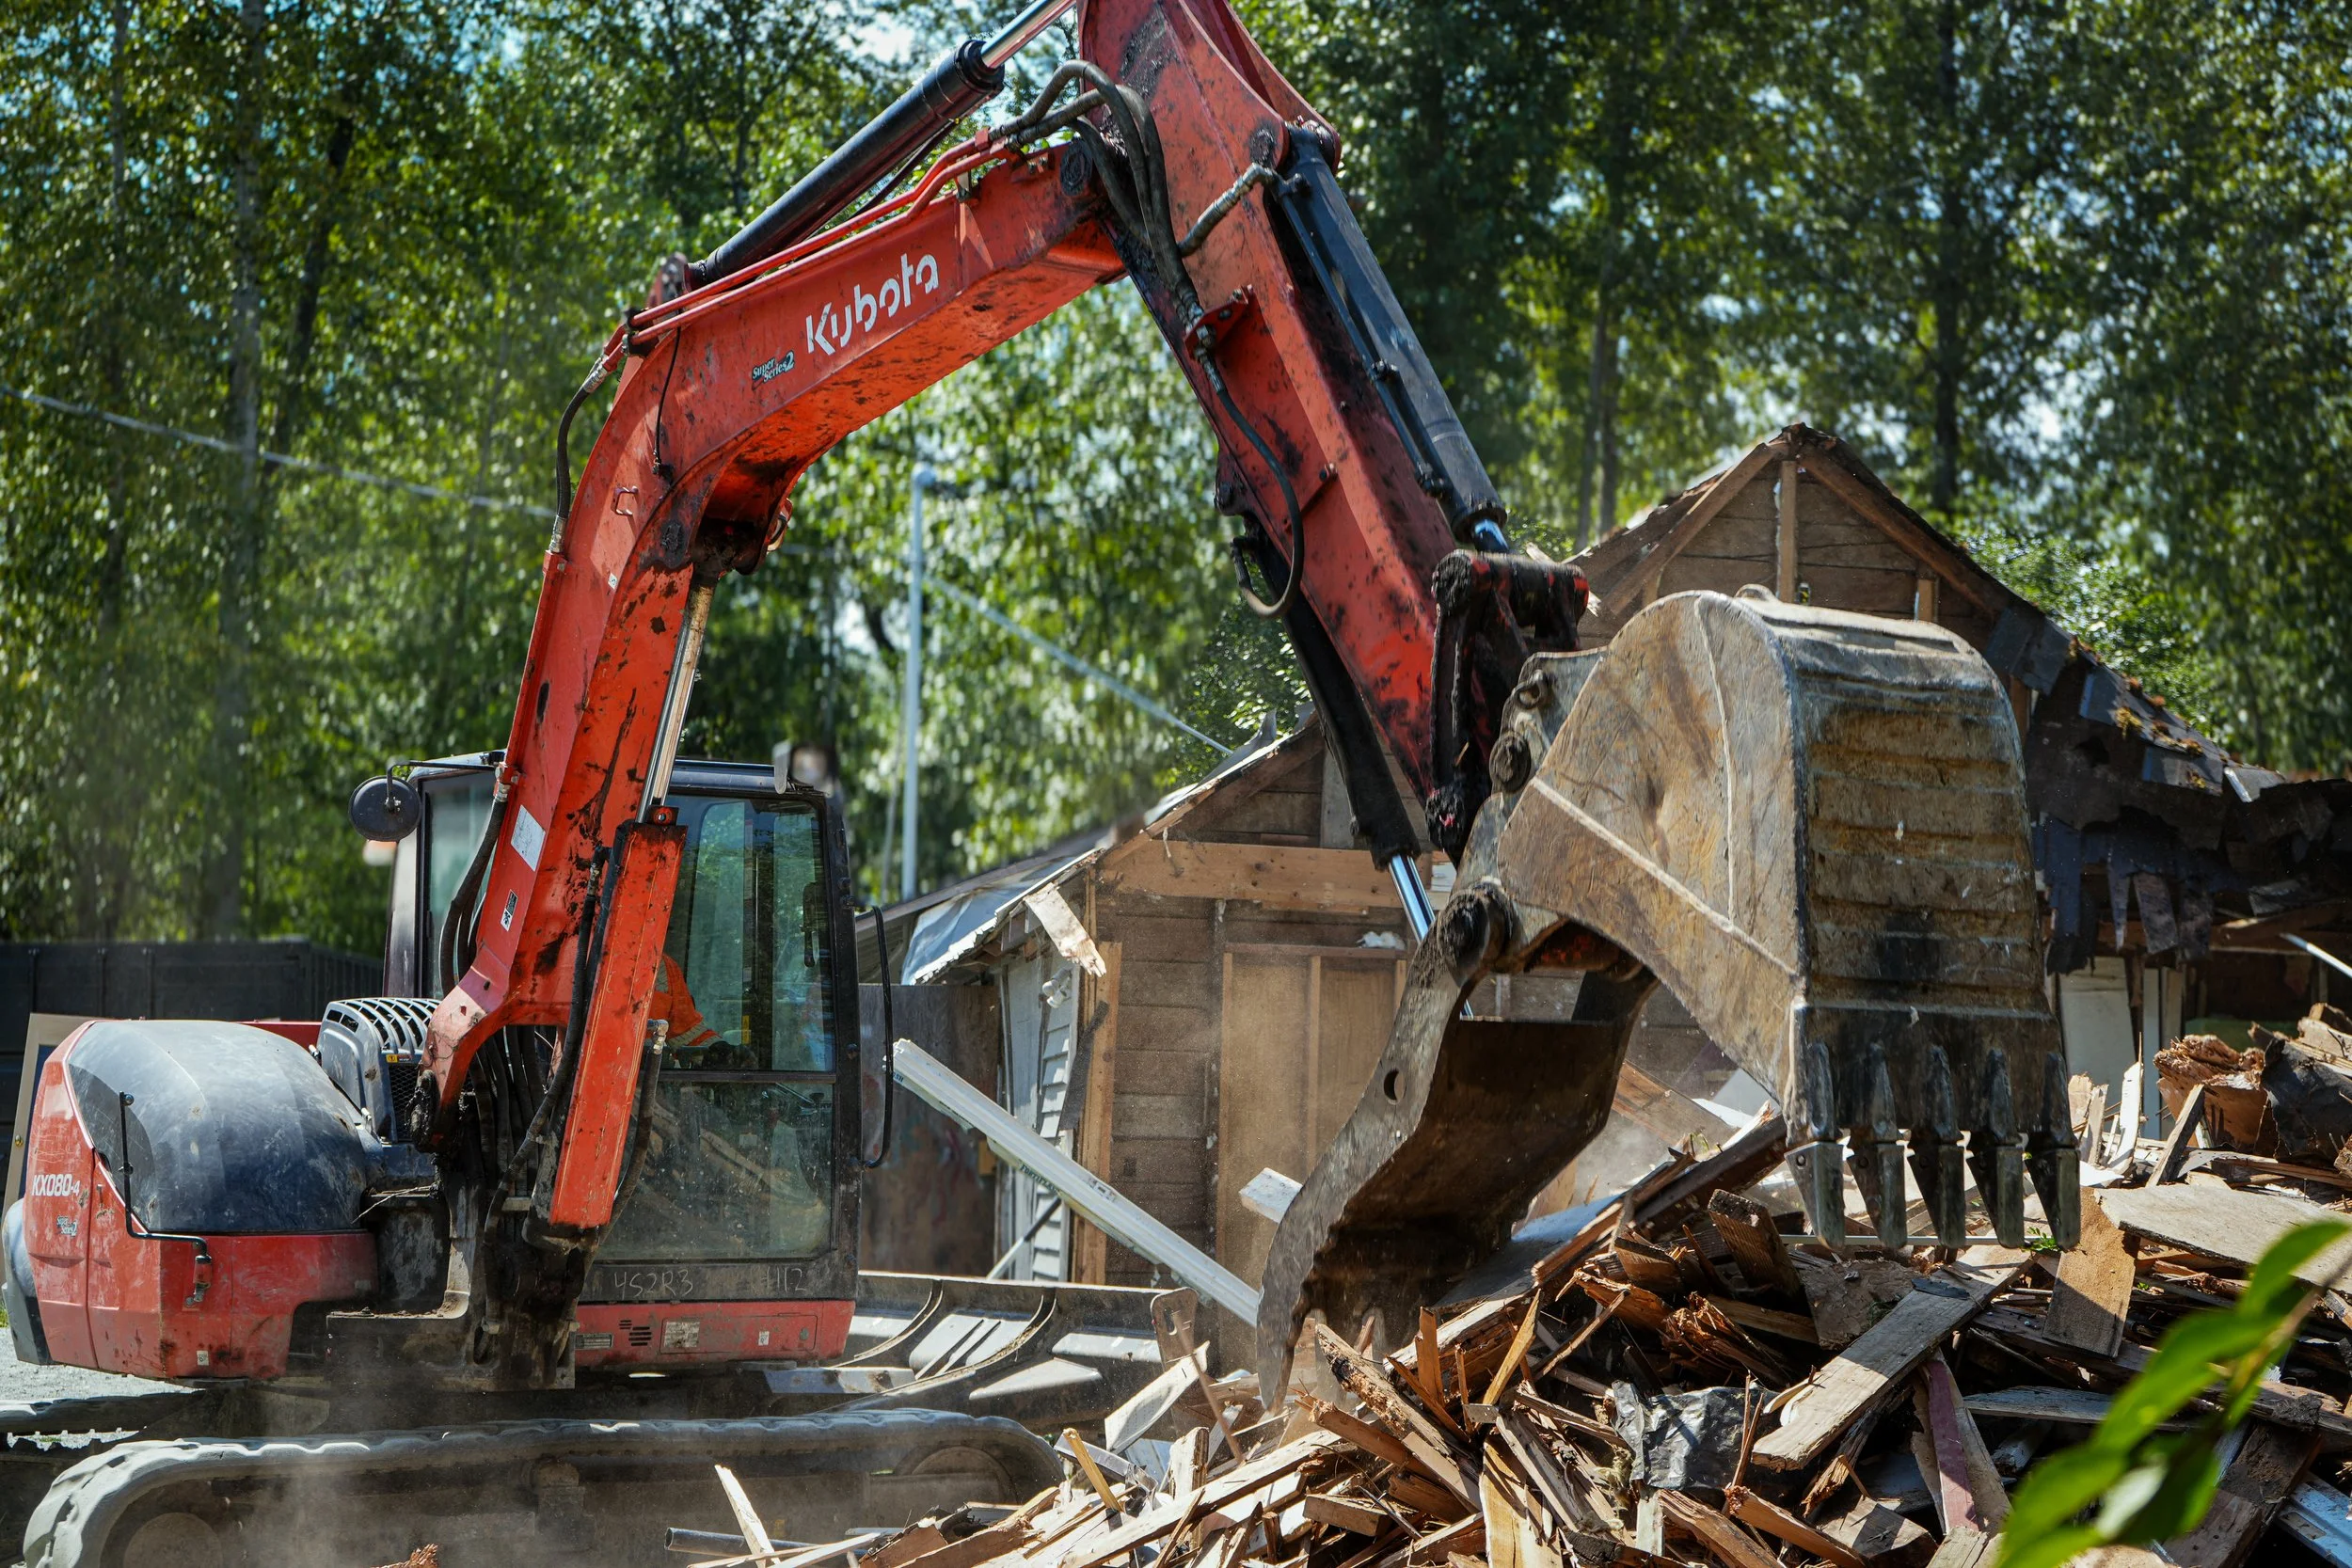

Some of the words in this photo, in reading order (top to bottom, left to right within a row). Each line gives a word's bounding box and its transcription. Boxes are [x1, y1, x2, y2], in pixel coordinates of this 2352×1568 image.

[806, 253, 939, 356] Kubota
[753, 357, 775, 380] Super
[32, 1173, 81, 1197] KX080-4
